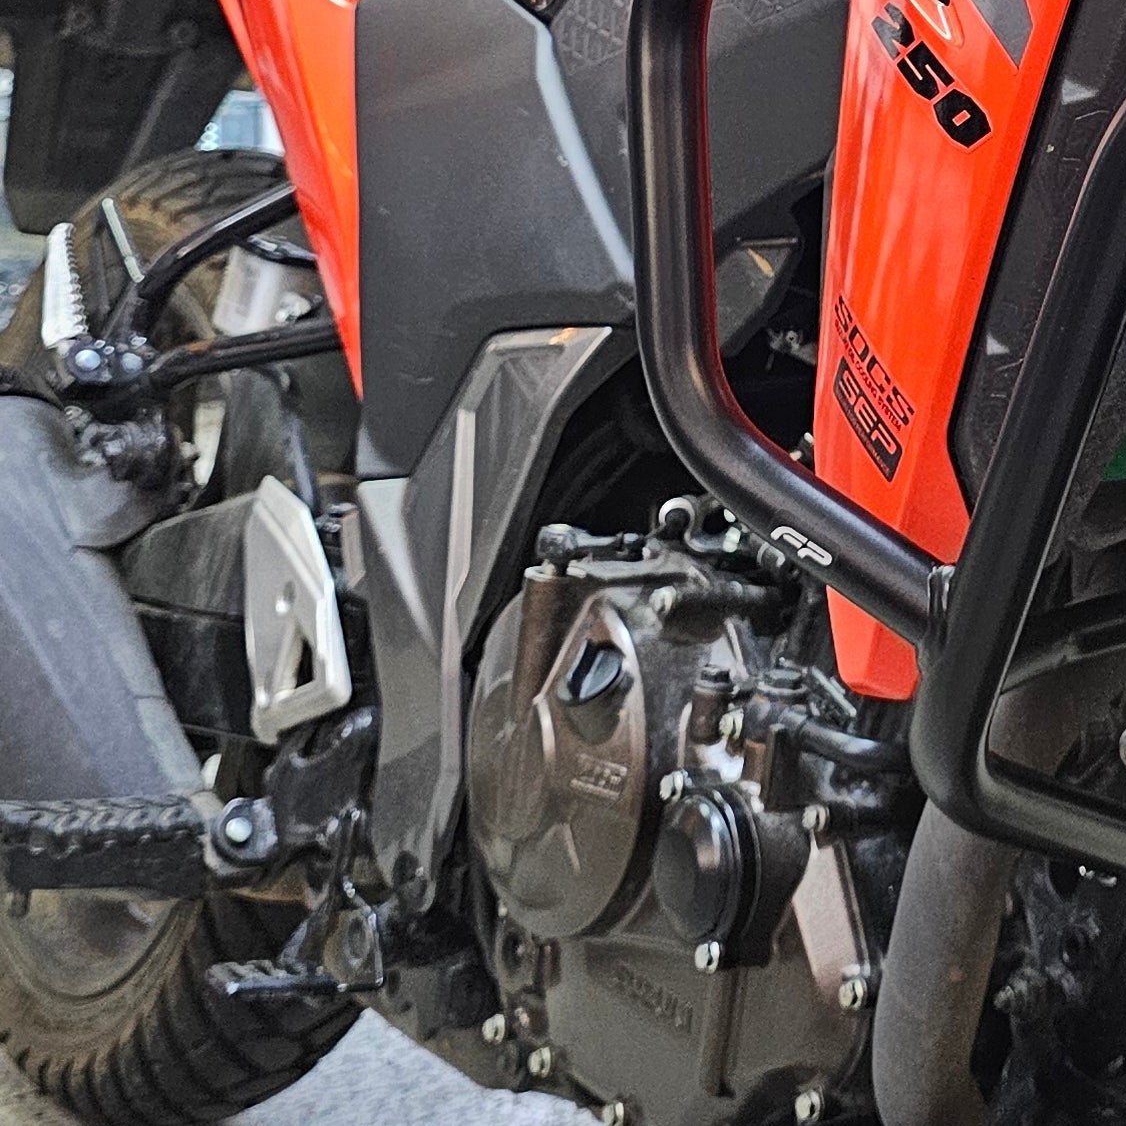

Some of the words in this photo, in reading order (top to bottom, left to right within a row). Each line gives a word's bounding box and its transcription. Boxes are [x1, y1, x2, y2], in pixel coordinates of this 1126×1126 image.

[871, 2, 992, 149] 250
[834, 295, 916, 427] SOCS
[839, 370, 898, 455] SEP
[770, 525, 833, 566] FP
